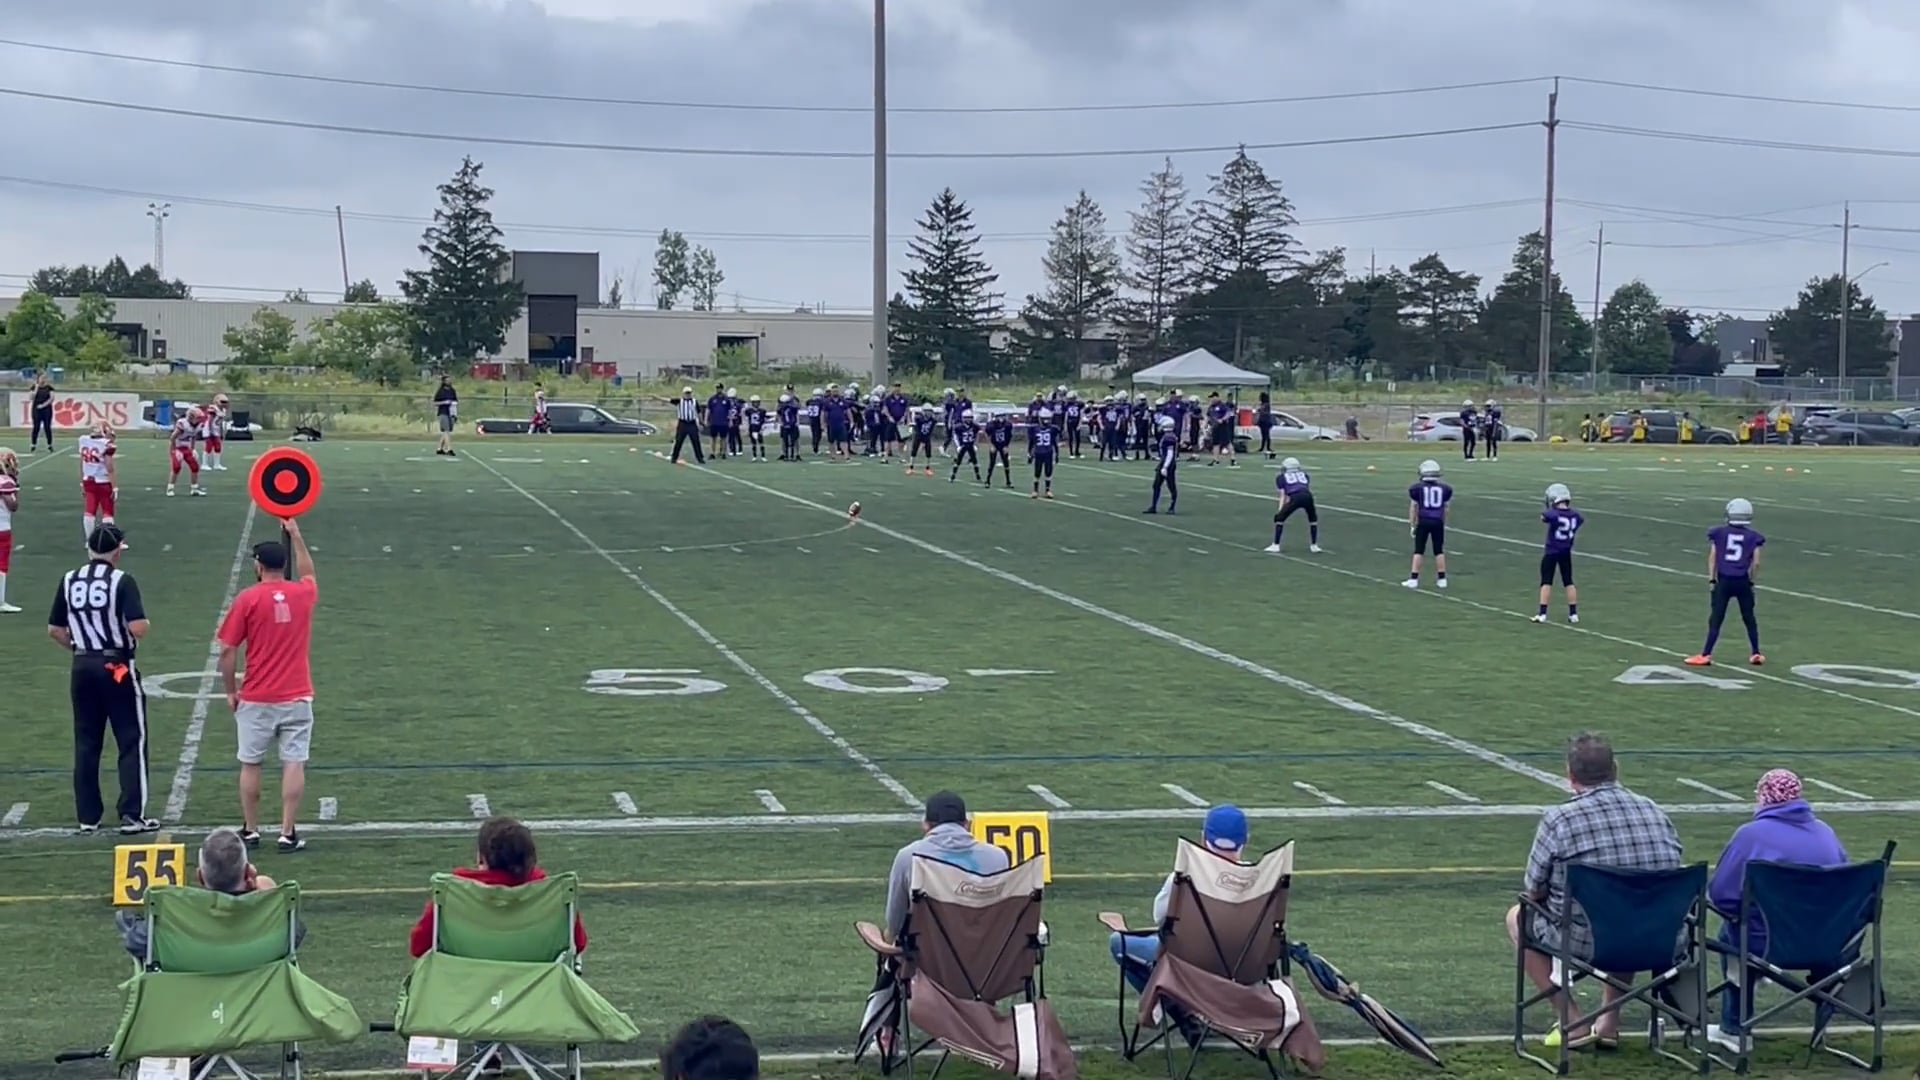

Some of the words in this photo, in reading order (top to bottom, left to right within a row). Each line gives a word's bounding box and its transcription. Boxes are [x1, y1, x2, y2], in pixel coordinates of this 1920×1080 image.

[1036, 432, 1051, 446] 39
[1422, 486, 1444, 508] 10
[1724, 533, 1745, 562] 5
[69, 579, 109, 609] 86
[125, 849, 177, 902] 55
